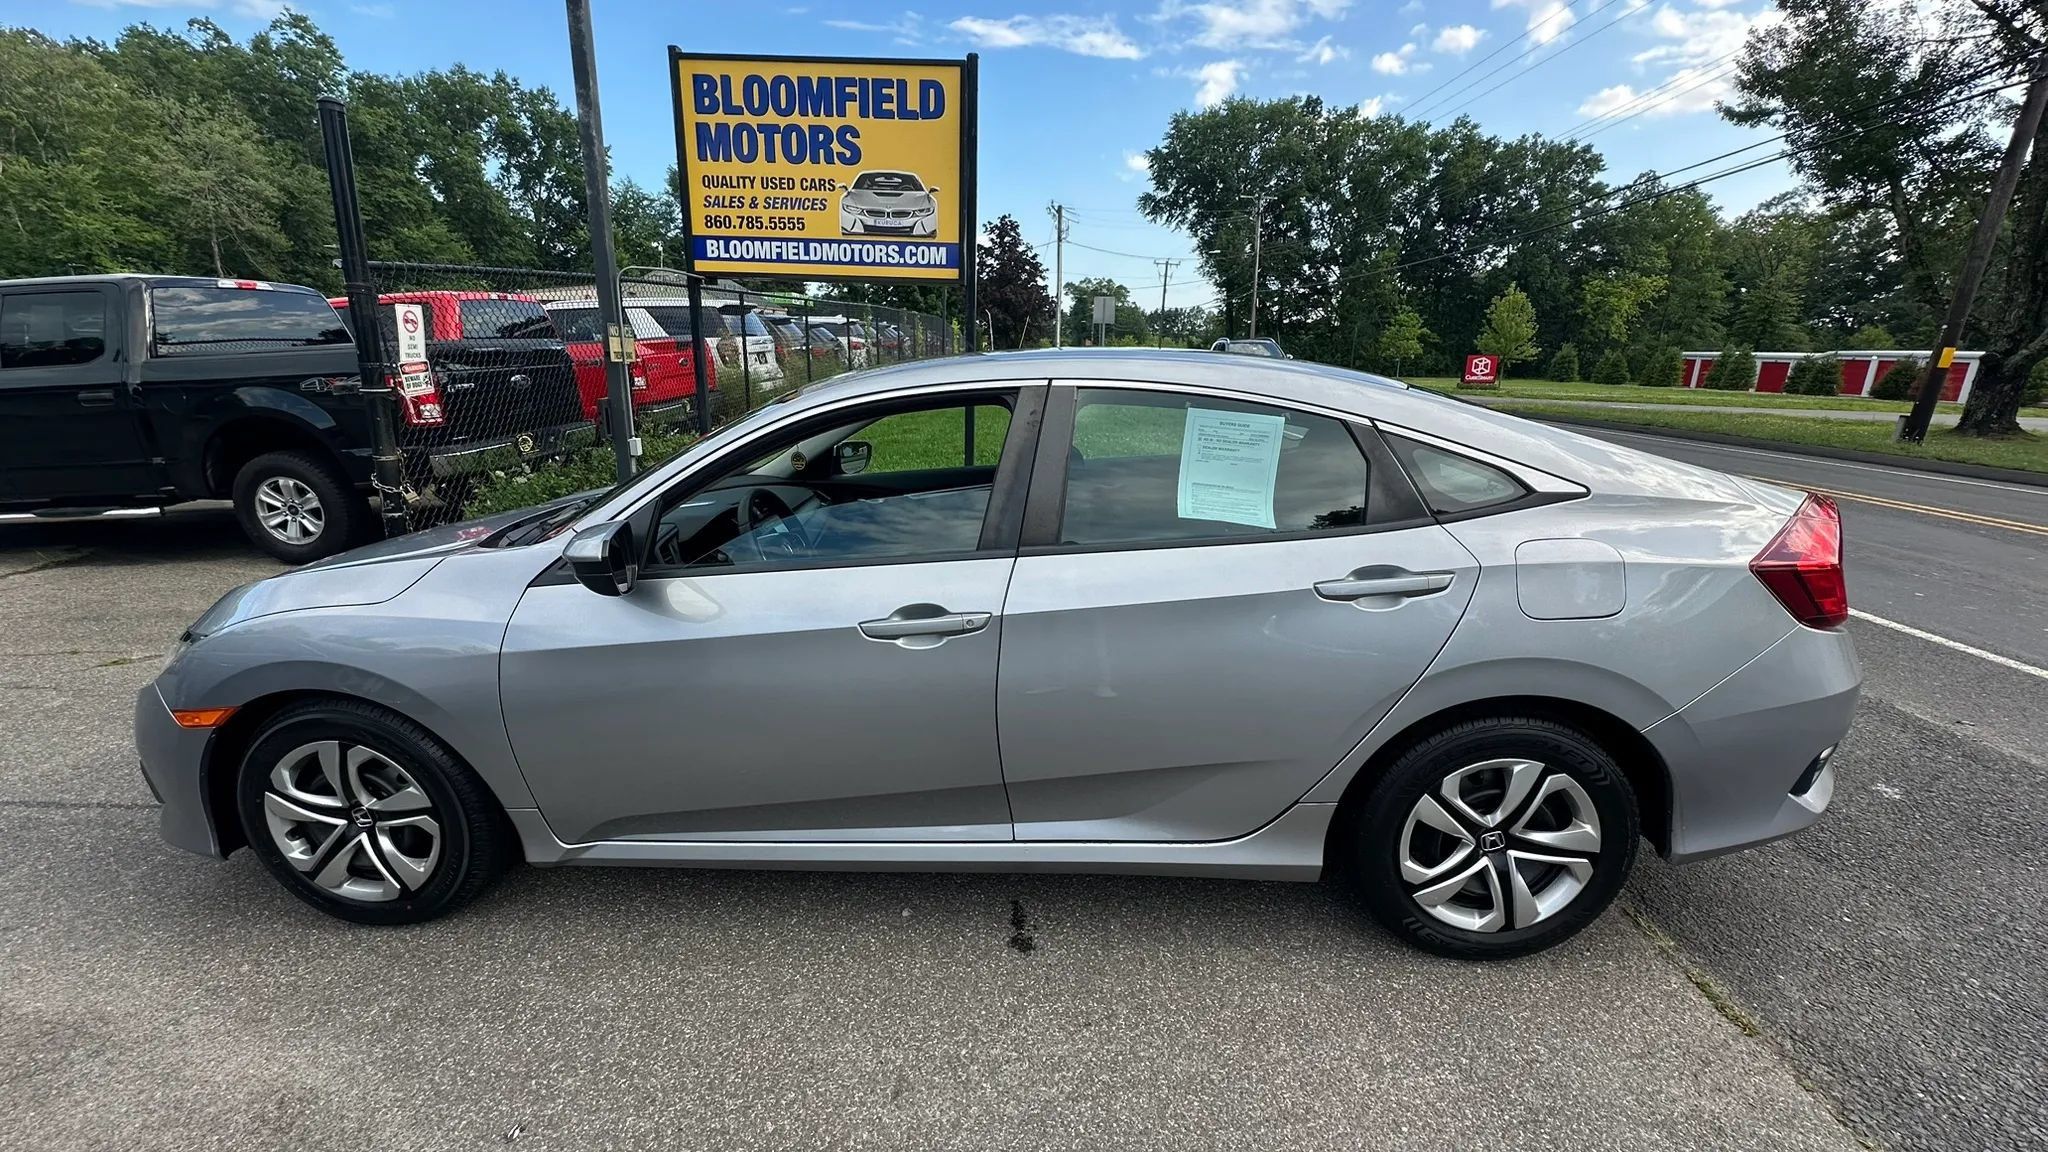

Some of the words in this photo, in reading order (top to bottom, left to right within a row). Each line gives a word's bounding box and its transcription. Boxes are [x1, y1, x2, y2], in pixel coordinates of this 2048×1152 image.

[692, 73, 946, 121] BLOOMFIELD
[694, 122, 862, 166] MOTORS
[702, 174, 756, 190] QUALITY
[760, 176, 796, 191] USED
[800, 177, 836, 192] CARS
[703, 194, 745, 209] SALES
[748, 196, 759, 209] &
[762, 196, 828, 211] SERVICES
[704, 214, 806, 231] 860.785.5555
[706, 239, 947, 265] BLOOMFIELDMOTORS.COM
[609, 325, 633, 337] NOCE
